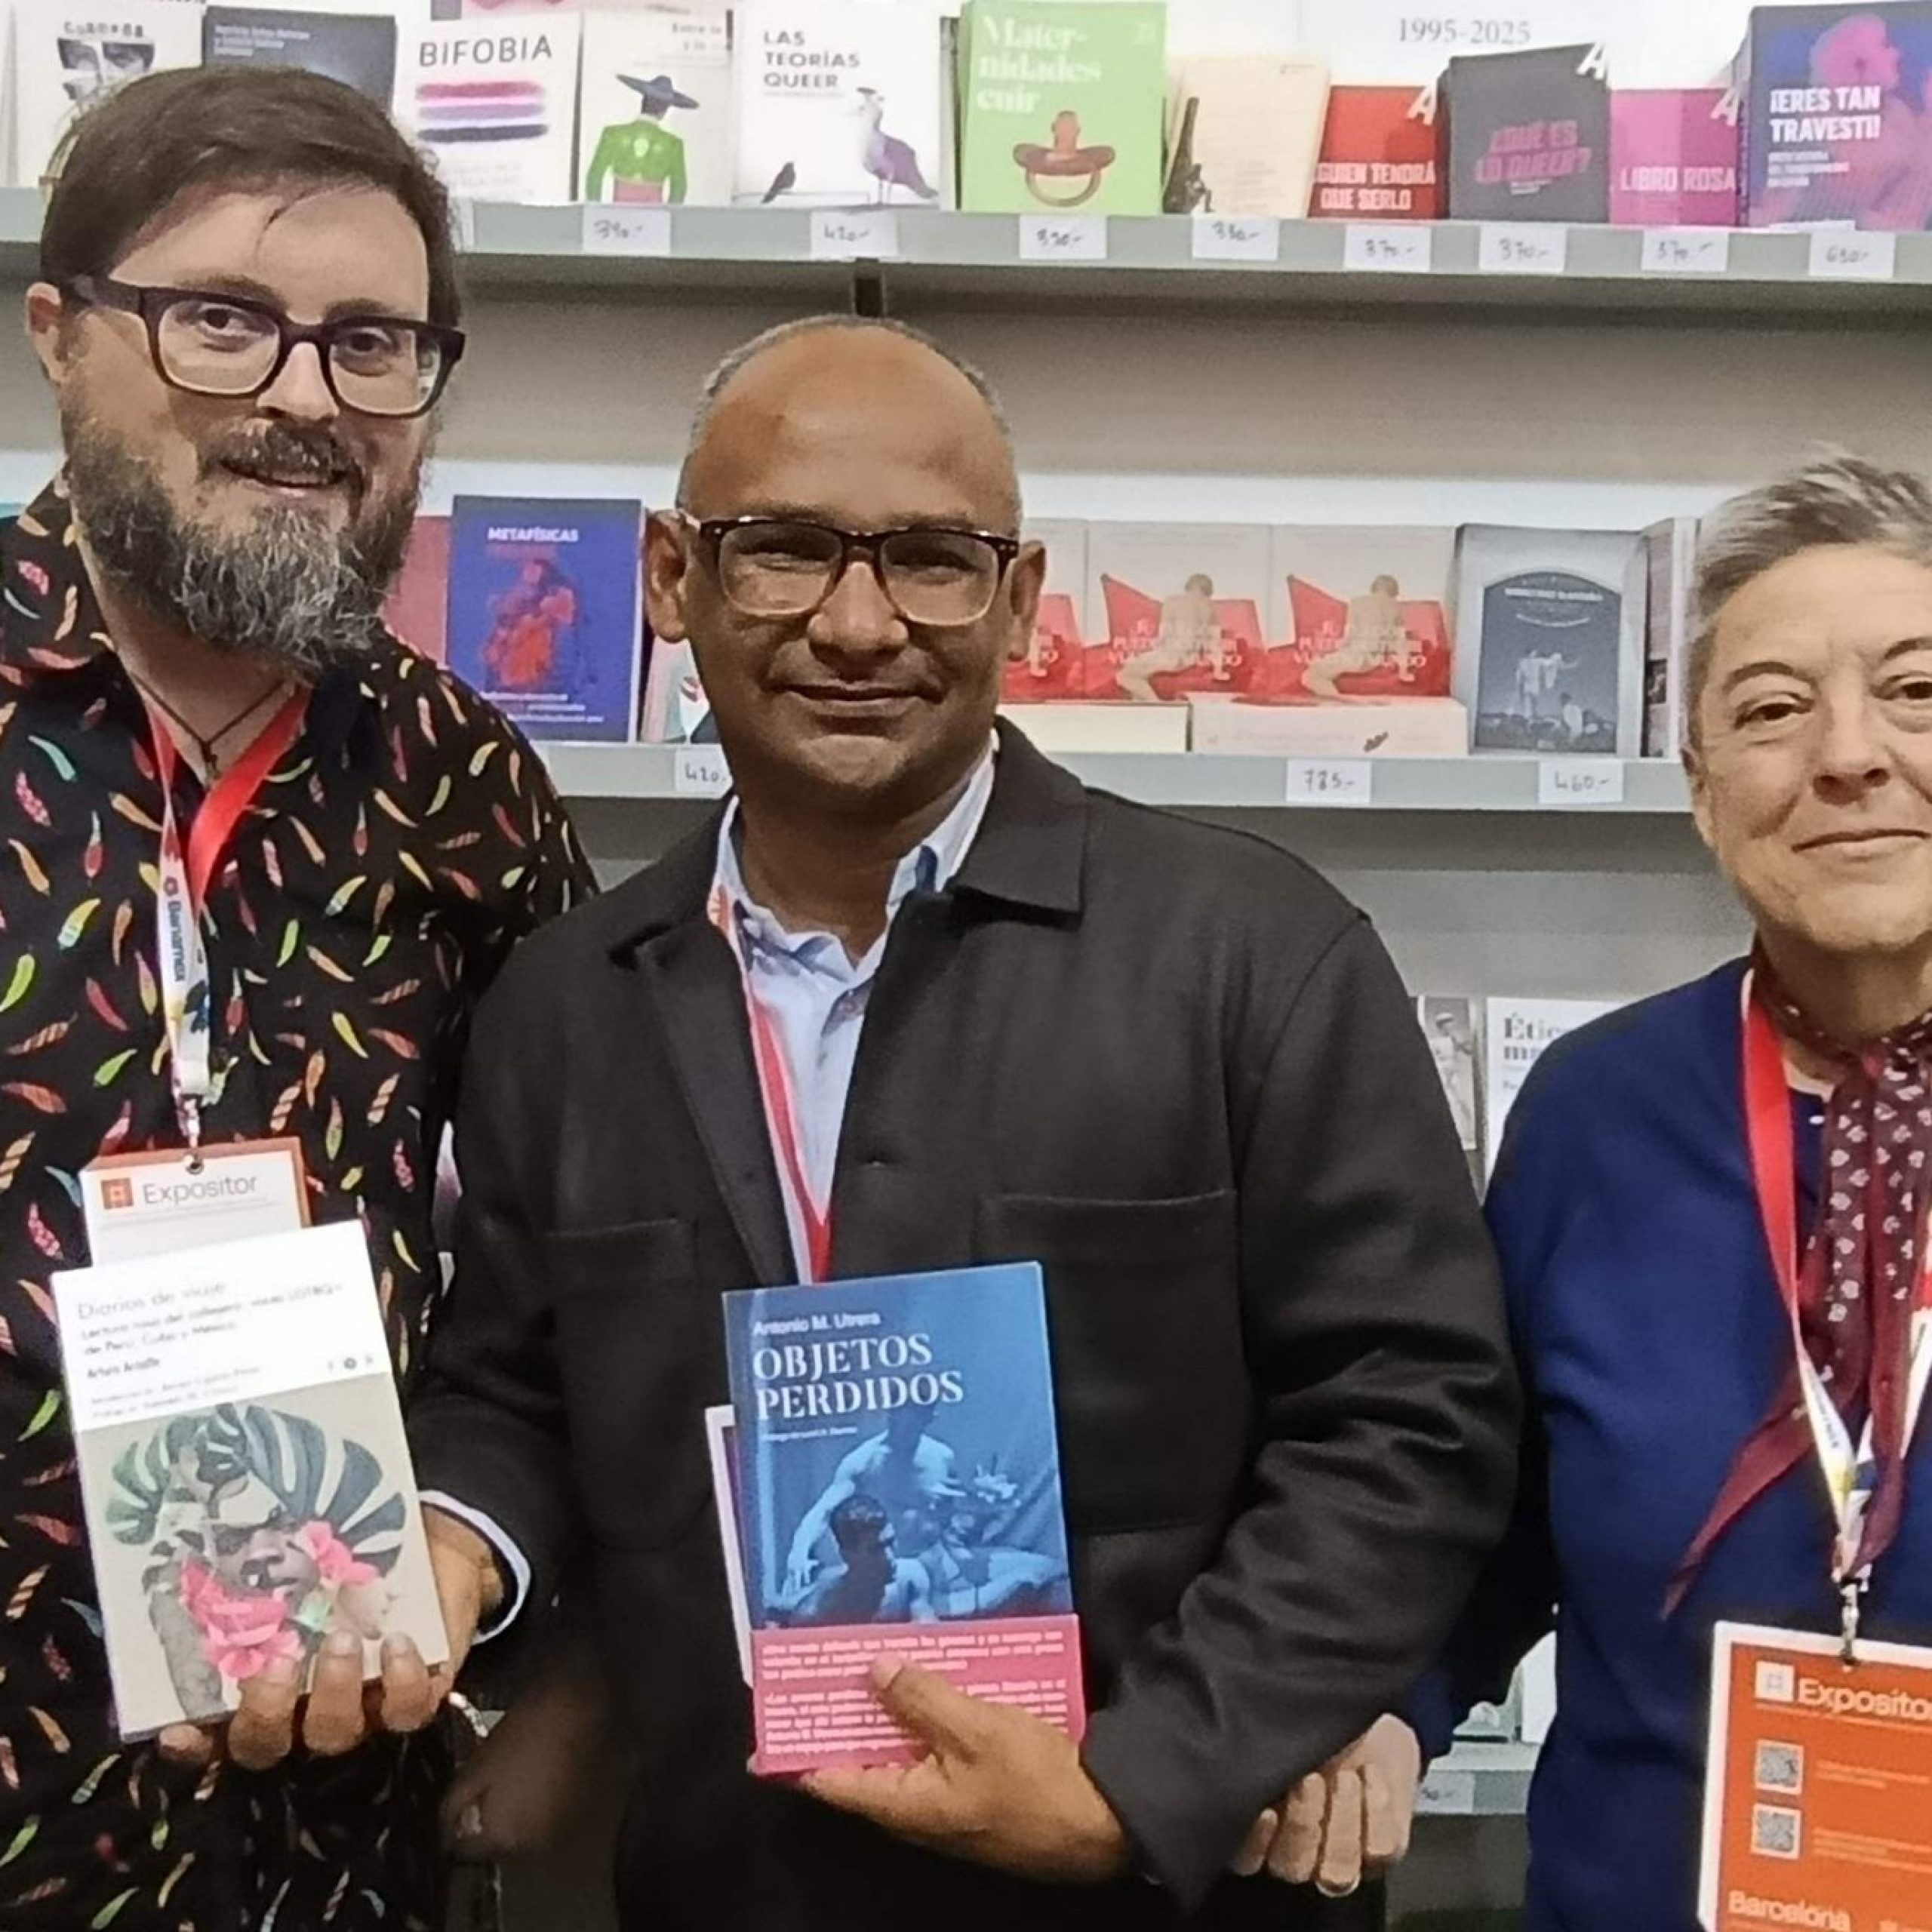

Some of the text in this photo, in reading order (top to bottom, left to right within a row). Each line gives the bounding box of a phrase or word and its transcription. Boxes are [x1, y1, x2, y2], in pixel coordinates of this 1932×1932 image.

[763, 30, 805, 45] LAS
[1398, 17, 1531, 45] 1995-2025
[420, 35, 552, 67] BIFOBIA
[765, 48, 860, 67] TEORÍAS
[764, 72, 838, 88] QUEER
[1835, 85, 1881, 112] TAN
[1620, 167, 1736, 192] LIBRO ROSA
[1321, 187, 1355, 210] QUE
[488, 525, 579, 543] METAFÍSICAS
[1504, 1010, 1562, 1040] Étic
[143, 1176, 257, 1206] Expositor
[753, 1317, 809, 1336] Antonio
[811, 1314, 832, 1331] M.
[752, 1333, 933, 1381] OBJETOS
[756, 1371, 964, 1421] PERDIDOS
[1798, 1677, 1932, 1721] Exposito
[1728, 1889, 1851, 1932] Barcelona
